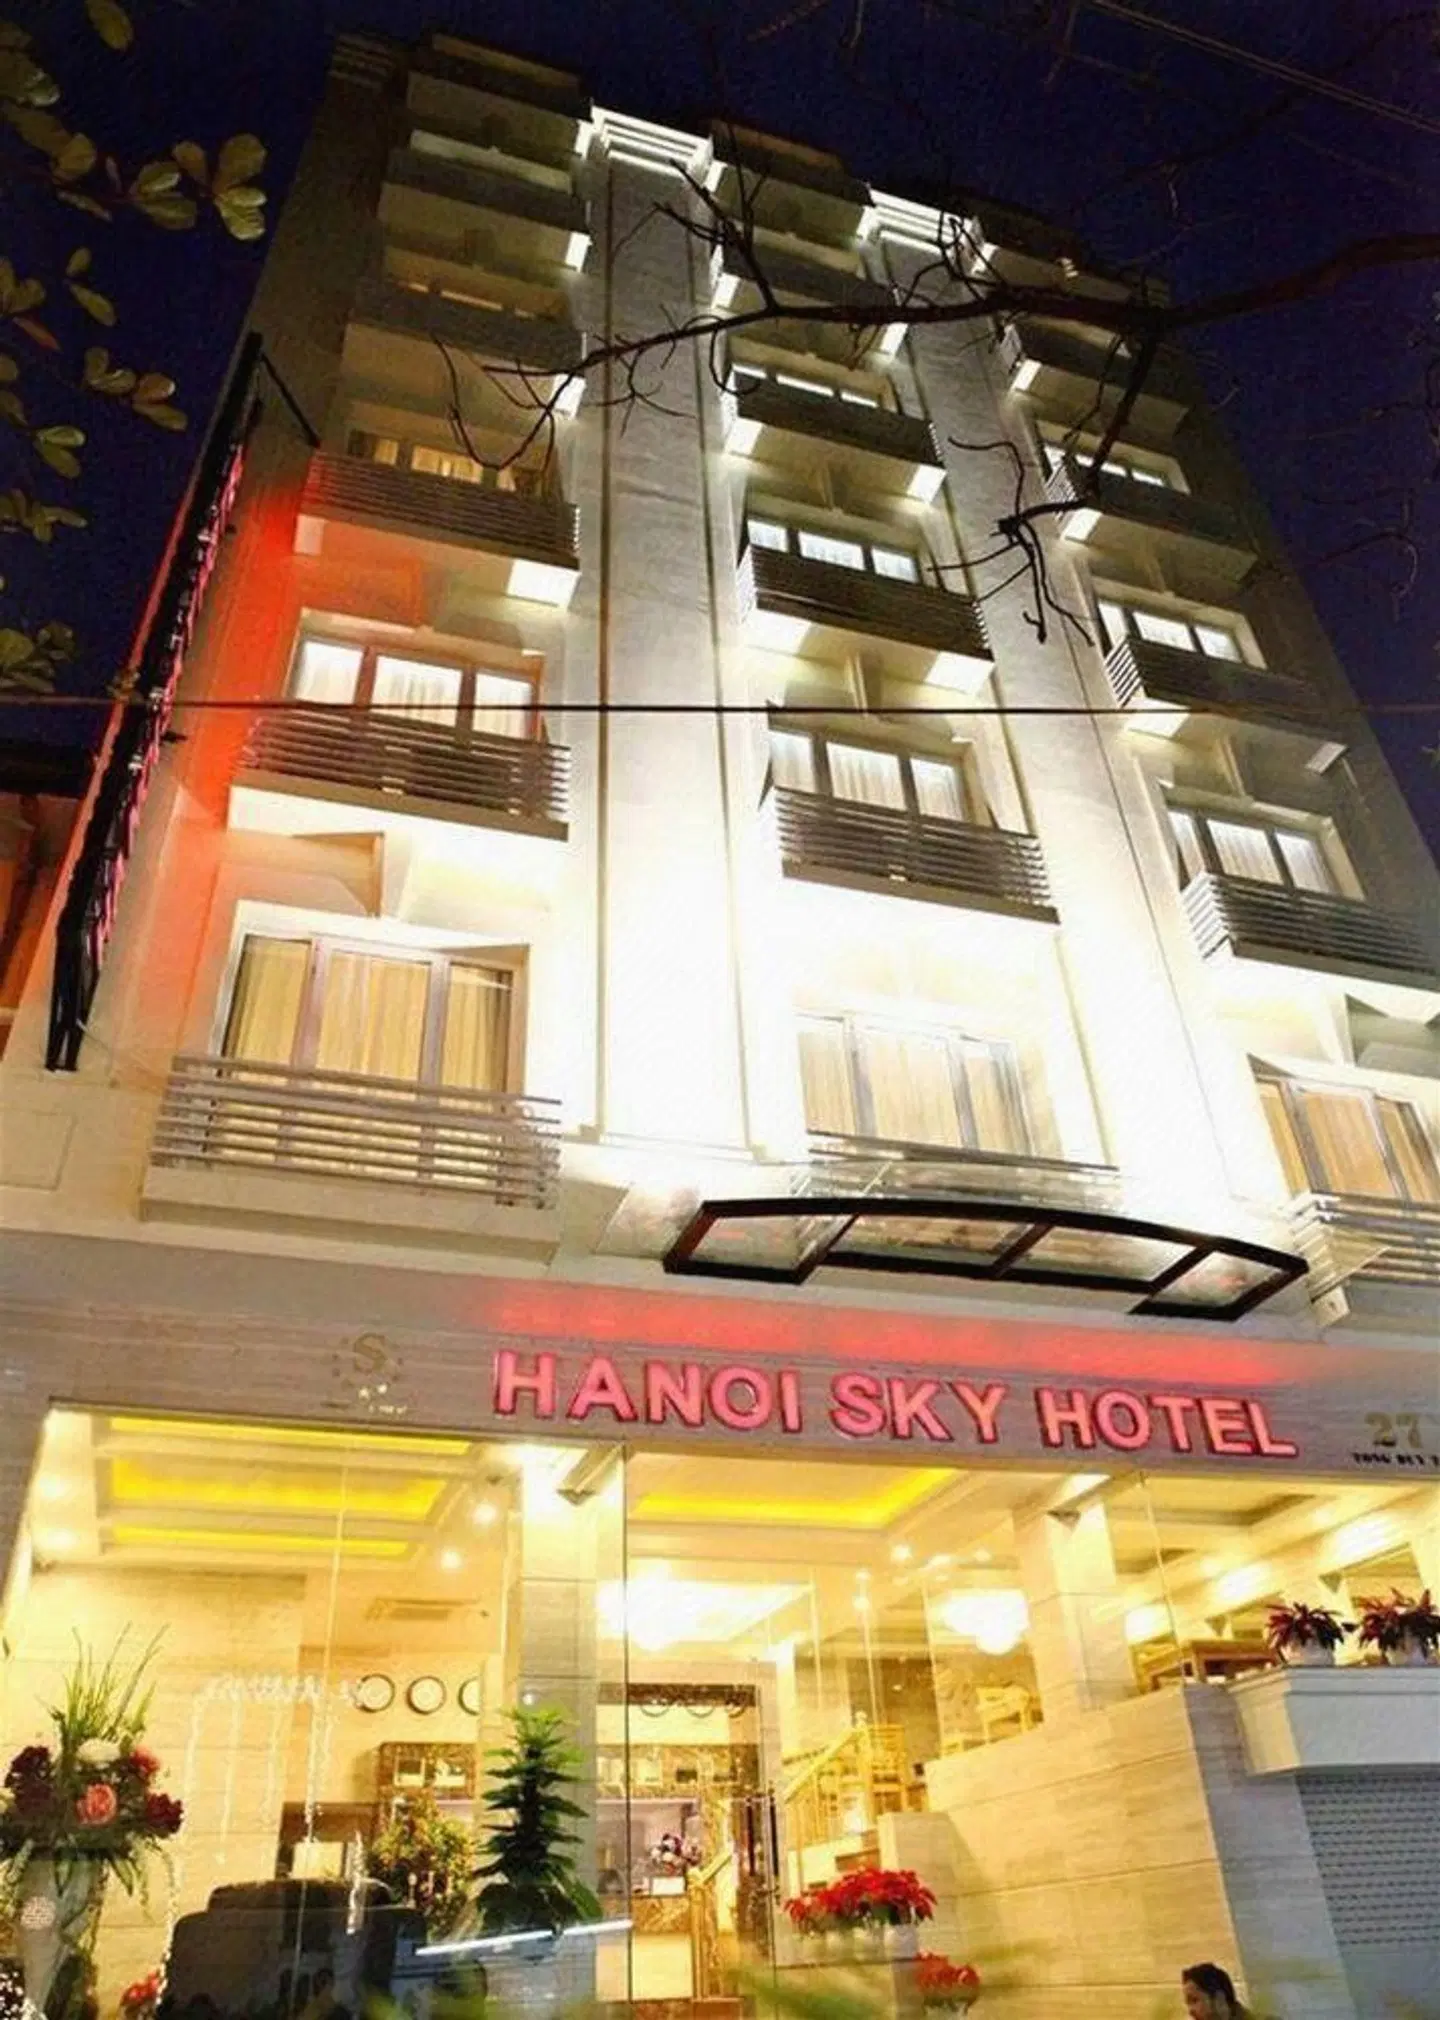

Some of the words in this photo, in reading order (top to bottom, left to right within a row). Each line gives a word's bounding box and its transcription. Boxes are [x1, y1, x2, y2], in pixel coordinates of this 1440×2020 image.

[494, 1350, 804, 1433] HANOI
[830, 1371, 1007, 1444] SKY
[1034, 1386, 1299, 1459] HOTEL
[1363, 1411, 1424, 1448] 27
